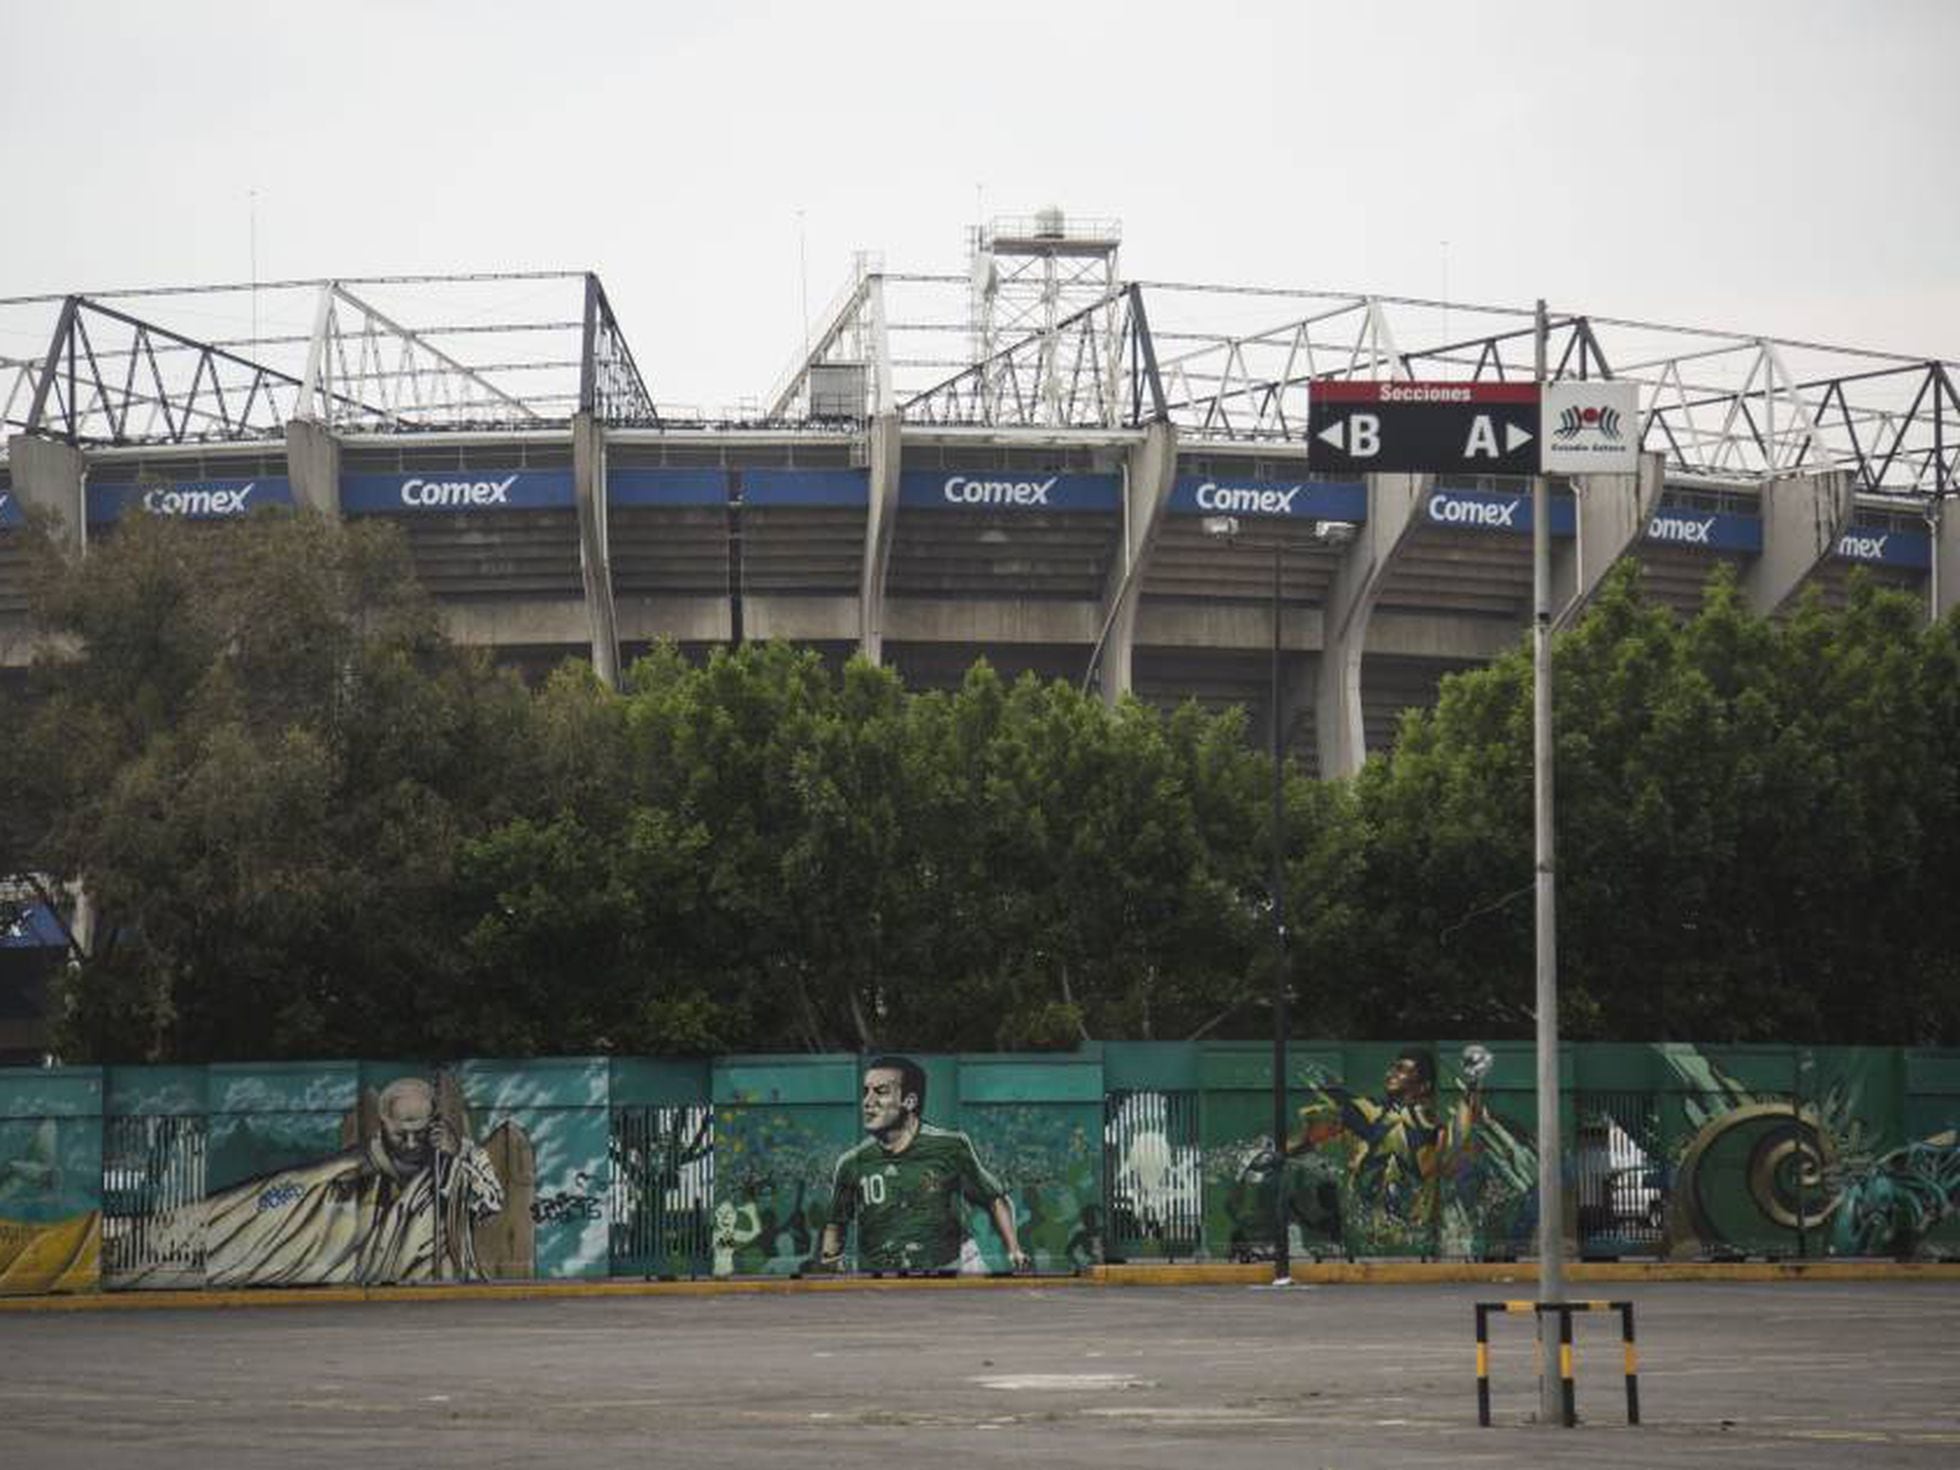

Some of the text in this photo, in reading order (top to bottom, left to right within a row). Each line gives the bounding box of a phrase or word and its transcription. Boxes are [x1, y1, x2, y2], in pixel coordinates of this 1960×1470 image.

[1379, 383, 1472, 401] Secciones
[1350, 414, 1499, 458] B A
[143, 482, 255, 514] Comex
[400, 474, 518, 505] Comex
[944, 476, 1058, 505] Comex
[1196, 482, 1302, 513] Comex
[1428, 494, 1519, 526] Comex
[1647, 516, 1717, 543] omex
[1838, 534, 1888, 558] mex
[859, 1174, 885, 1205] 10
